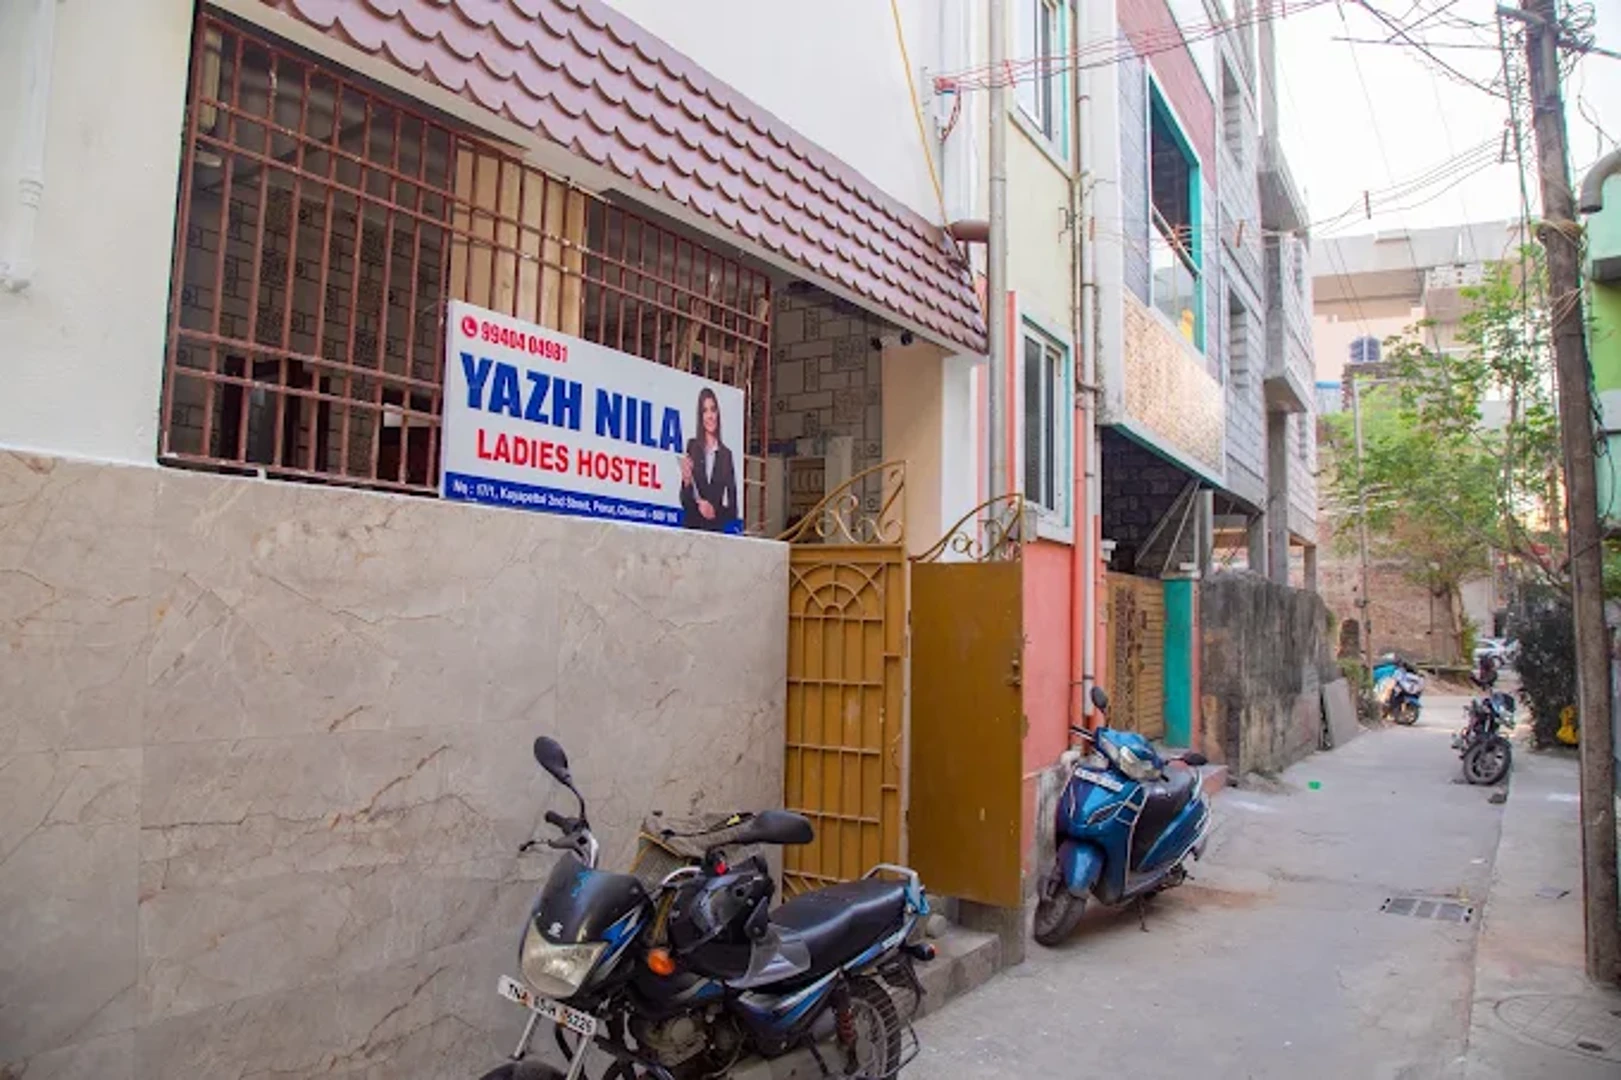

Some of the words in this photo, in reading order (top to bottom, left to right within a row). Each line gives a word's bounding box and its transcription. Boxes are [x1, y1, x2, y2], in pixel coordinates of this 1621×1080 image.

[460, 352, 582, 431] YAZH
[595, 388, 684, 454] NILA
[477, 428, 569, 473] LADIES
[576, 449, 662, 490] HOSTEL
